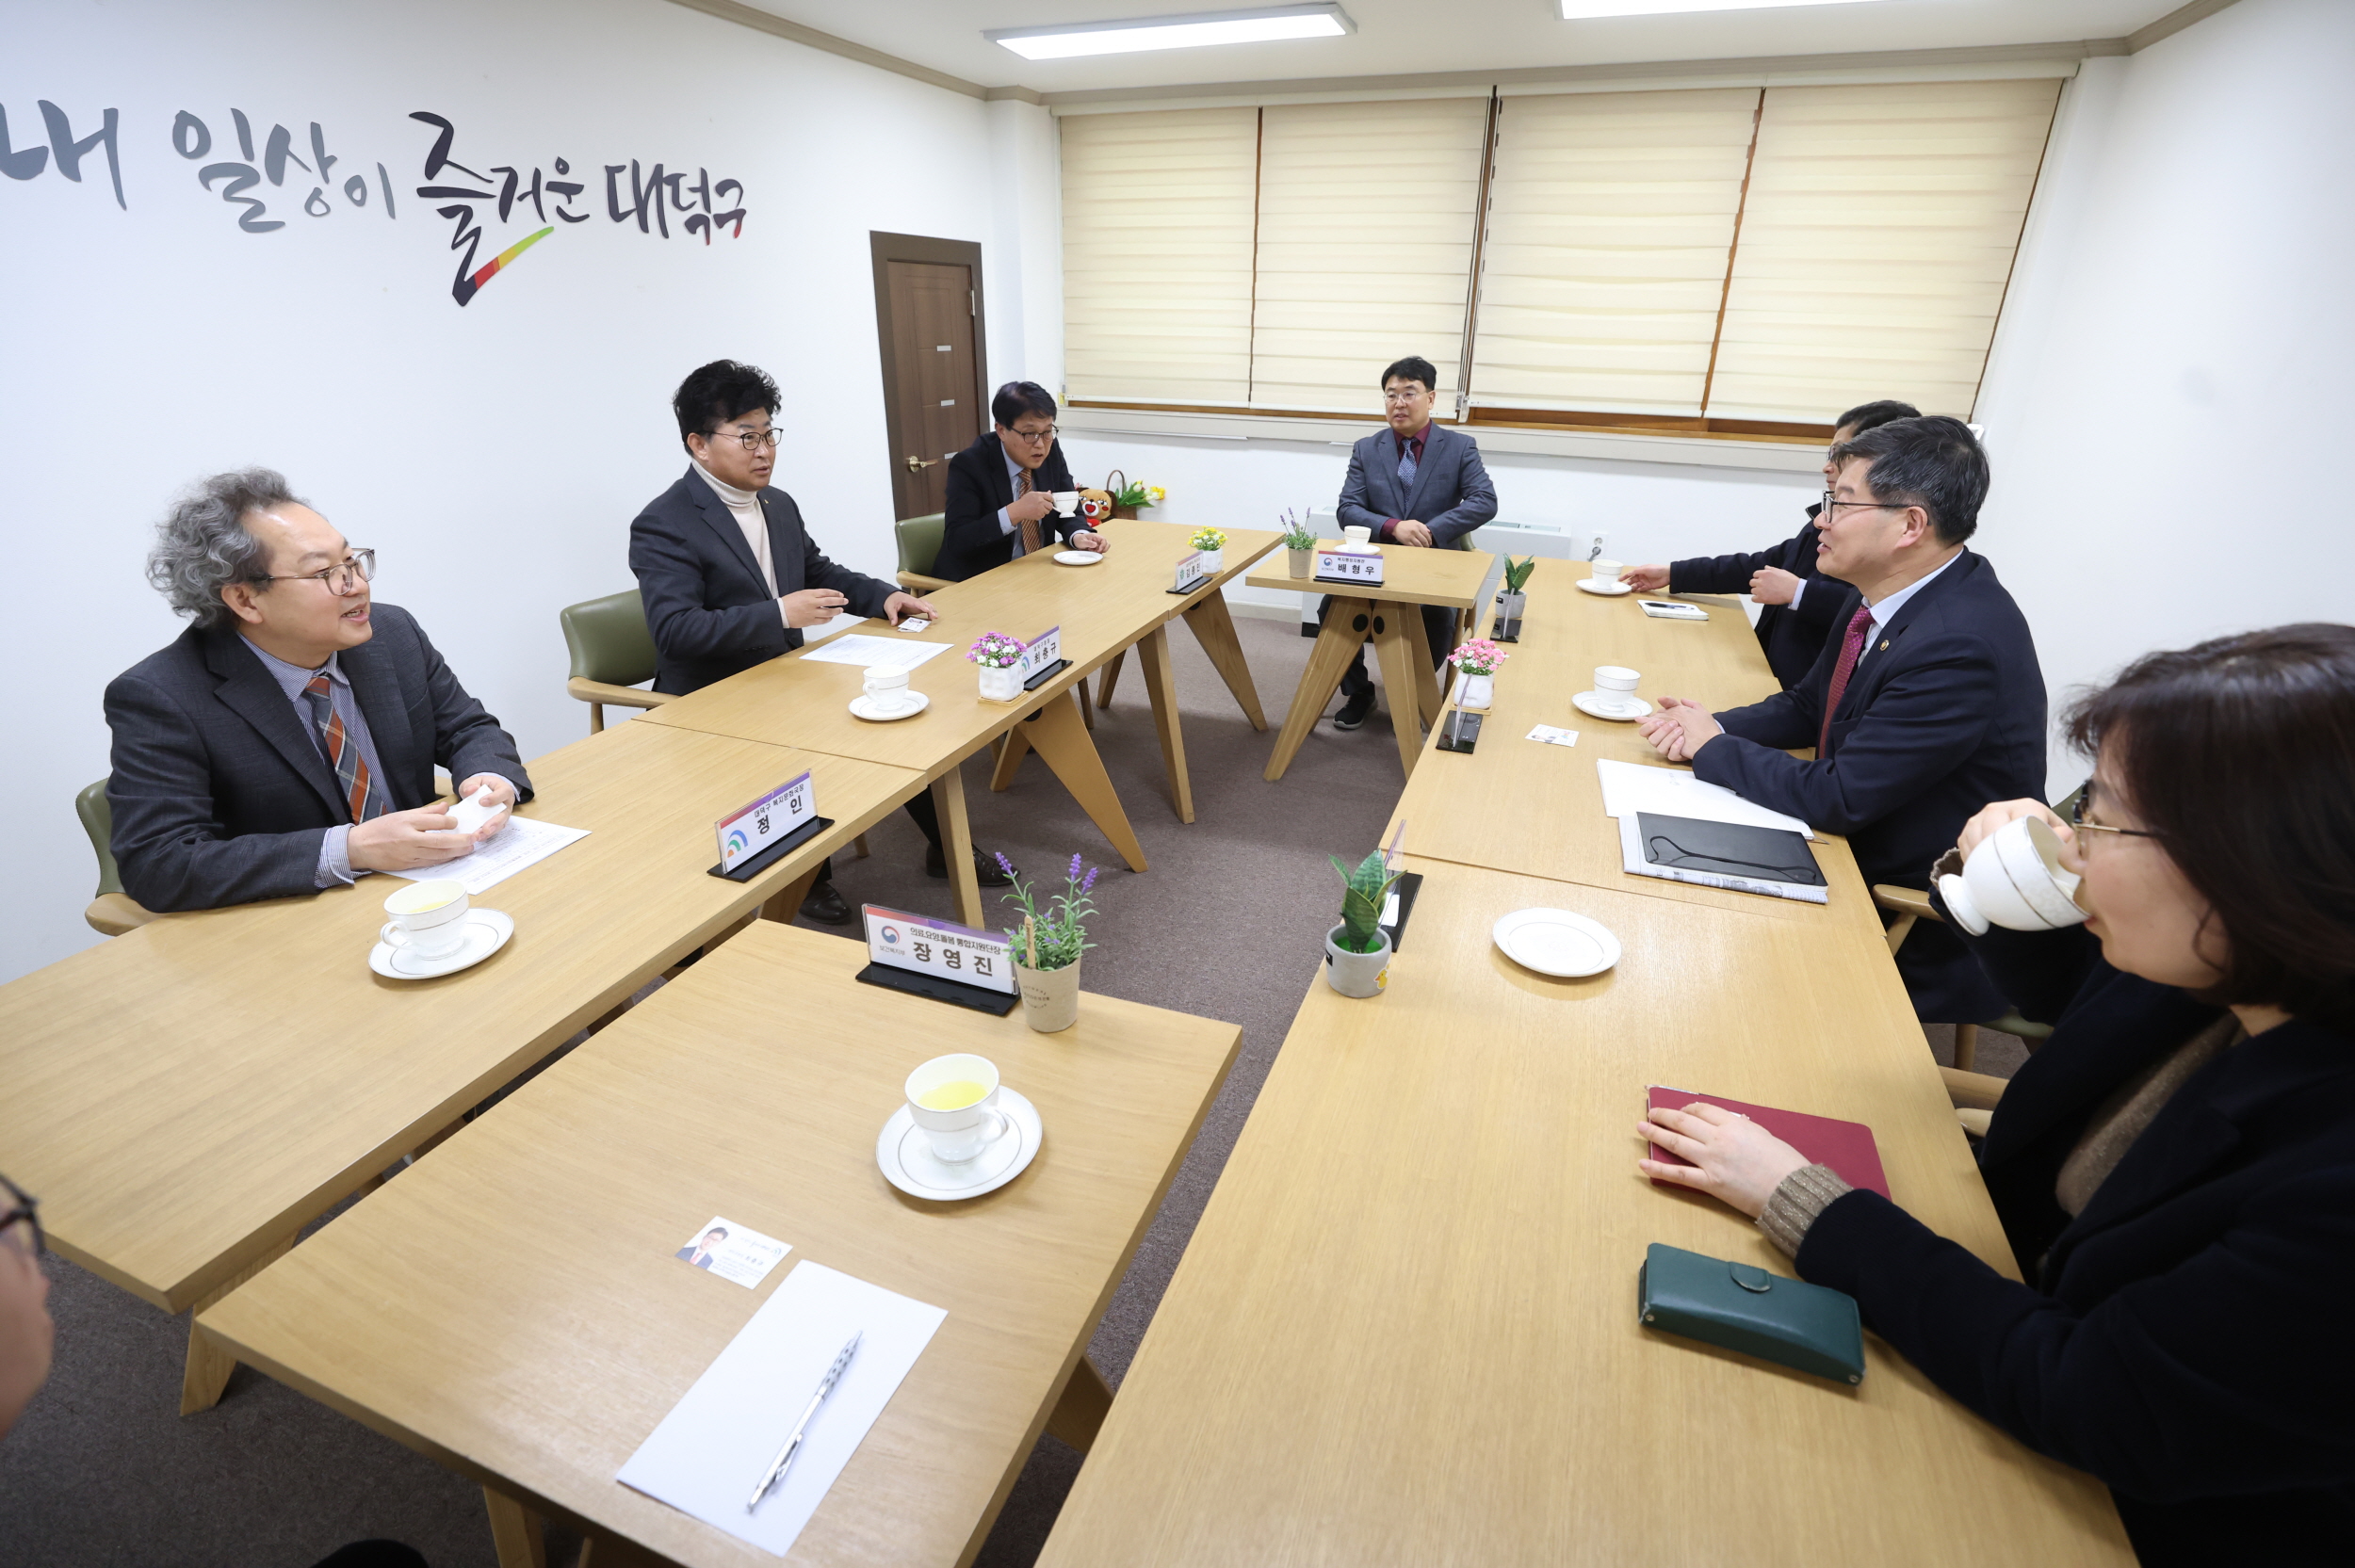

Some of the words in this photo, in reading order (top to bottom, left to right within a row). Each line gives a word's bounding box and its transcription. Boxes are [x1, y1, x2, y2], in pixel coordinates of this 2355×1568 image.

[0, 100, 127, 211] 내
[172, 107, 396, 234] 일상이
[409, 111, 591, 307] 즐거운
[605, 158, 747, 246] 대덕구
[754, 802, 771, 818] 대덕구
[879, 945, 906, 956] 보건복지부
[956, 936, 1001, 956] 통합지원단장
